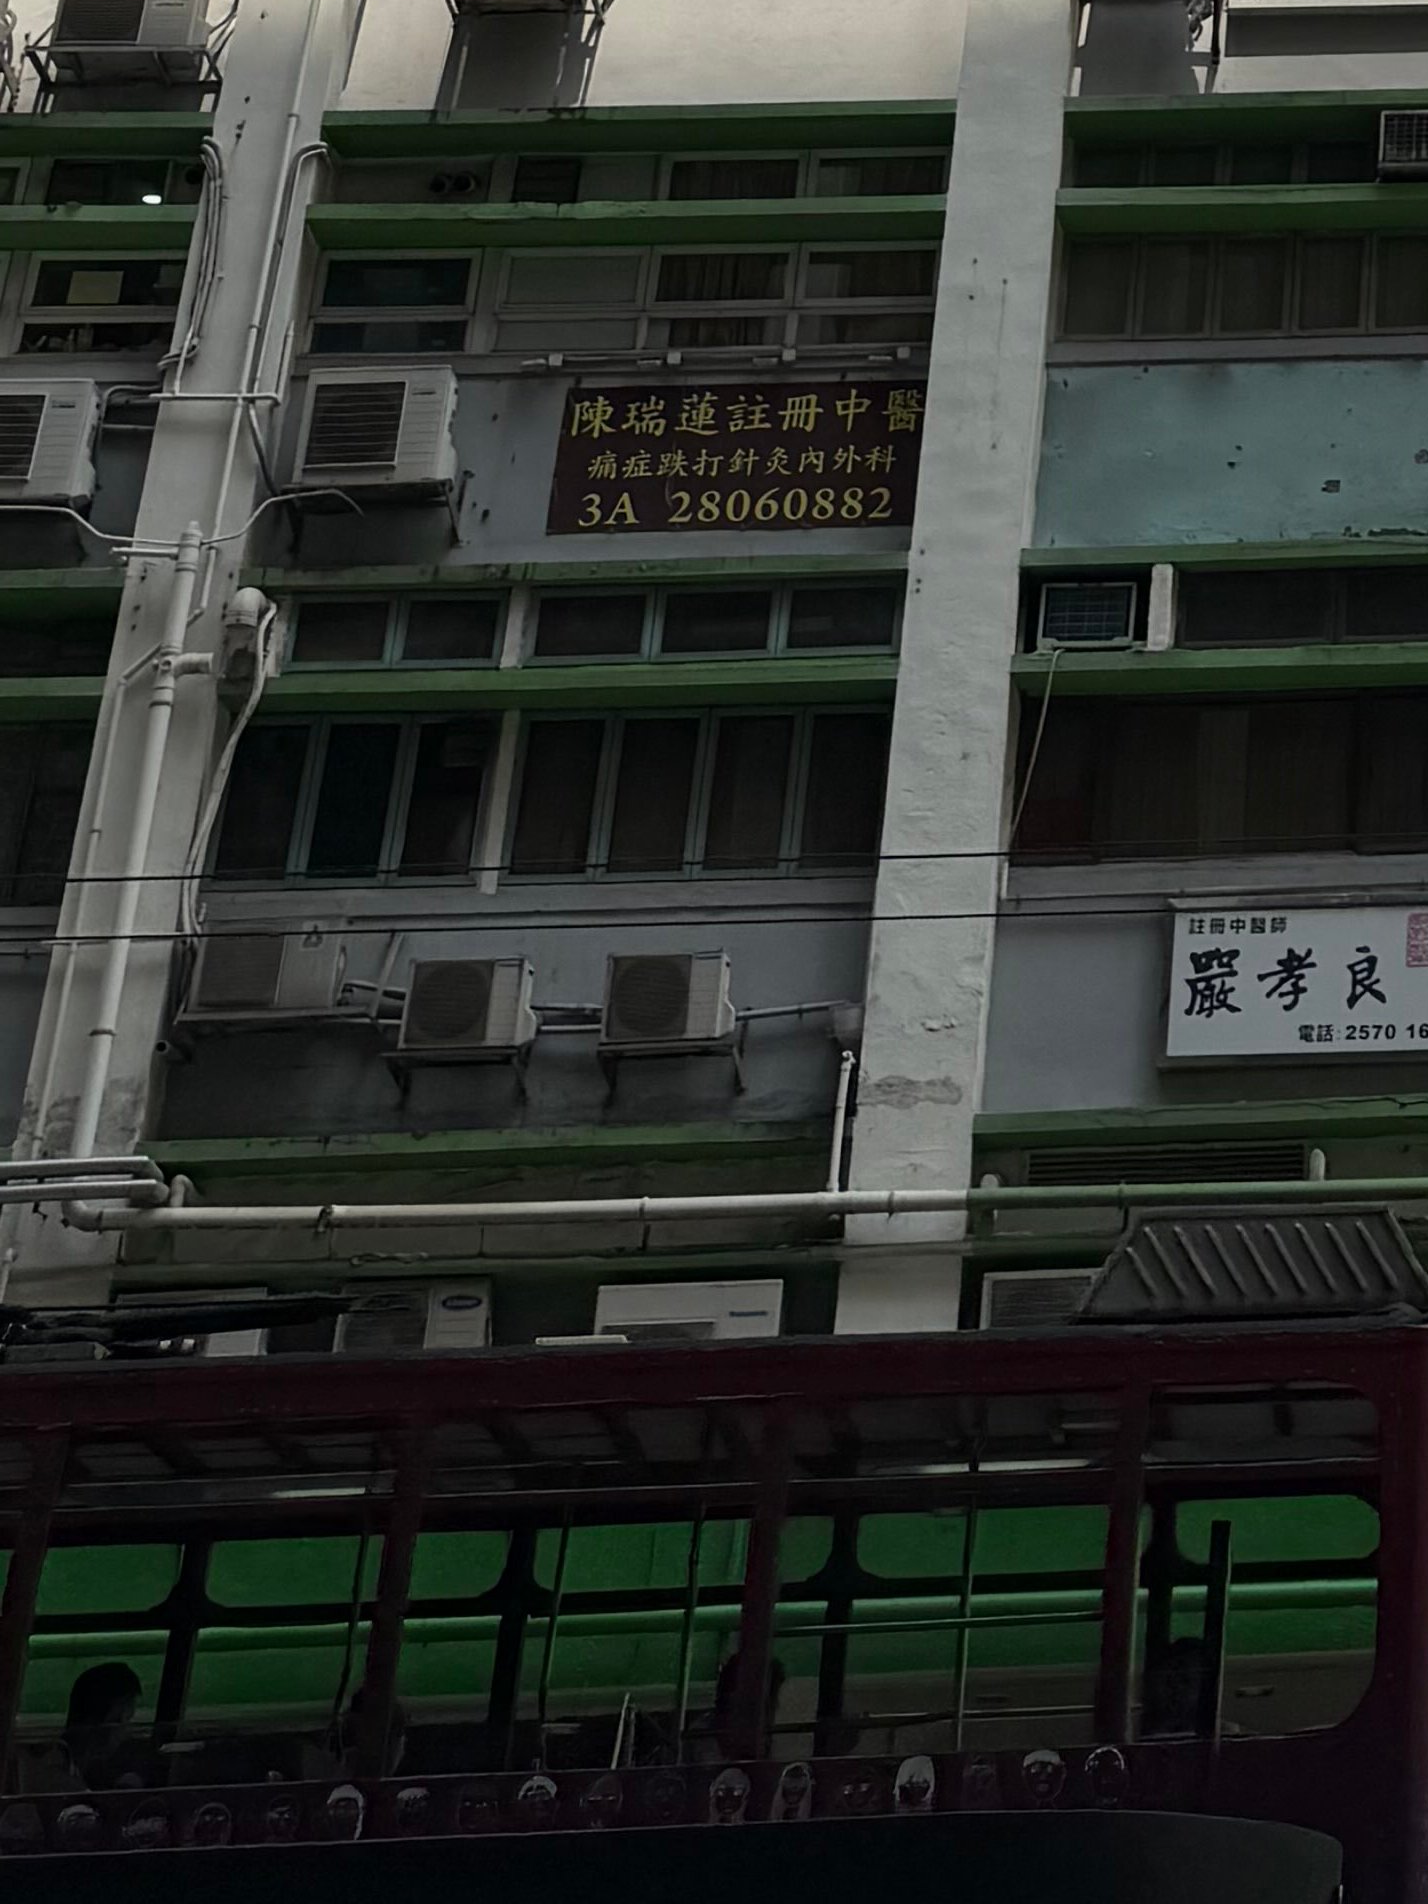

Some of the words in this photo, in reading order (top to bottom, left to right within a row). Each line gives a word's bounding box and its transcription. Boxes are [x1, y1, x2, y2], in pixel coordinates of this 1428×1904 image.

[570, 389, 925, 438] 陳瑞蓮註冊中醫
[578, 492, 640, 526] 3A
[668, 487, 893, 524] 28060882
[1188, 917, 1287, 935] 註冊中醫師
[1184, 946, 1387, 1018] 嚴孝良
[1345, 1024, 1396, 1041] 2570
